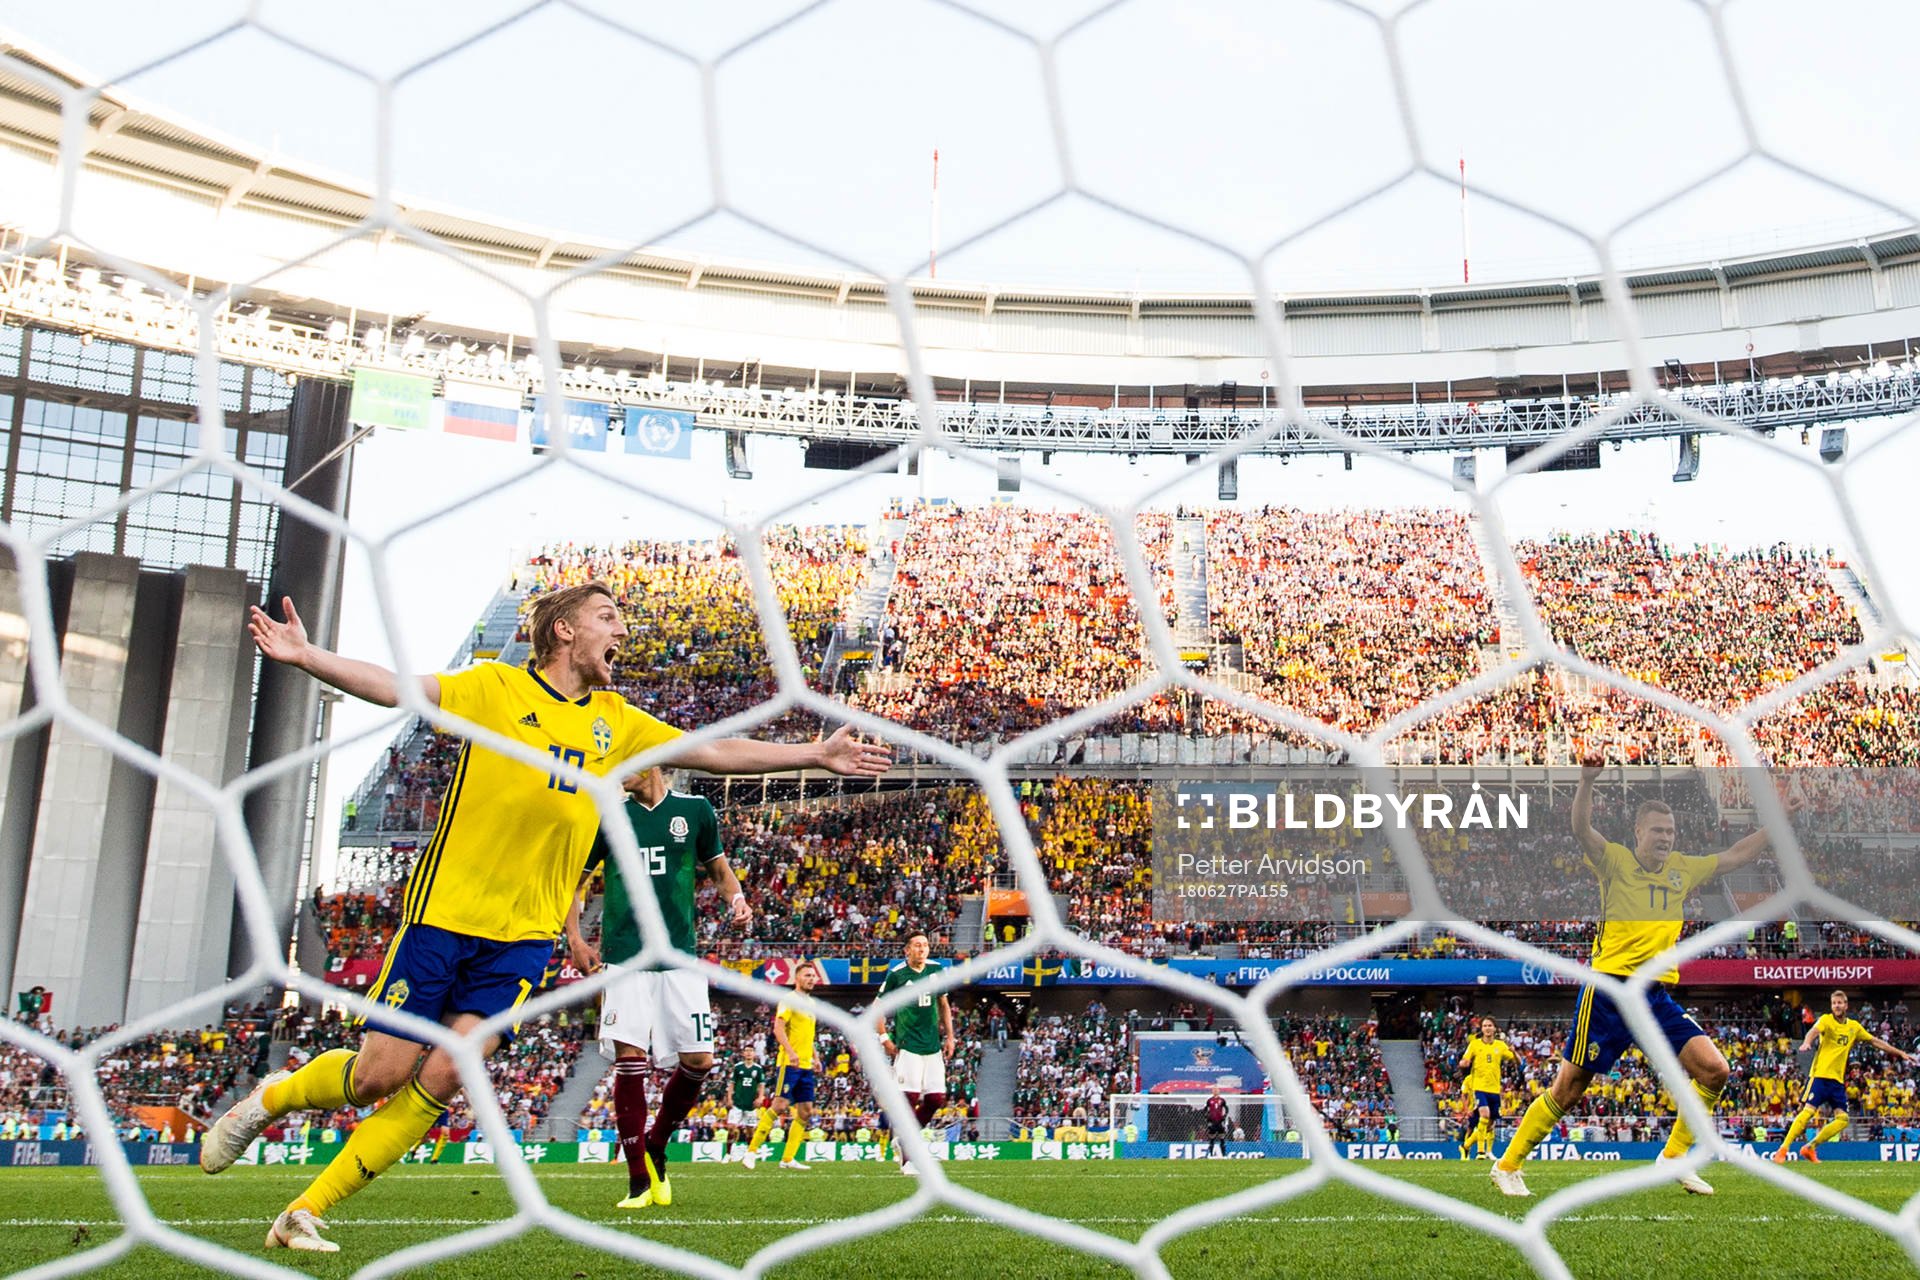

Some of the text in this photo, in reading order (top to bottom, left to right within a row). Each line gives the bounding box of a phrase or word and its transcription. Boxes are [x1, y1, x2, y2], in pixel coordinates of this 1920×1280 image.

[548, 744, 585, 794] 10
[1239, 967, 1271, 980] FIFA
[1326, 967, 1390, 980] РОССИИ
[1753, 966, 1874, 979] ЕКАТЕРИНБУРГ
[691, 1013, 712, 1042] 15
[954, 1143, 1000, 1160] 蒙牛
